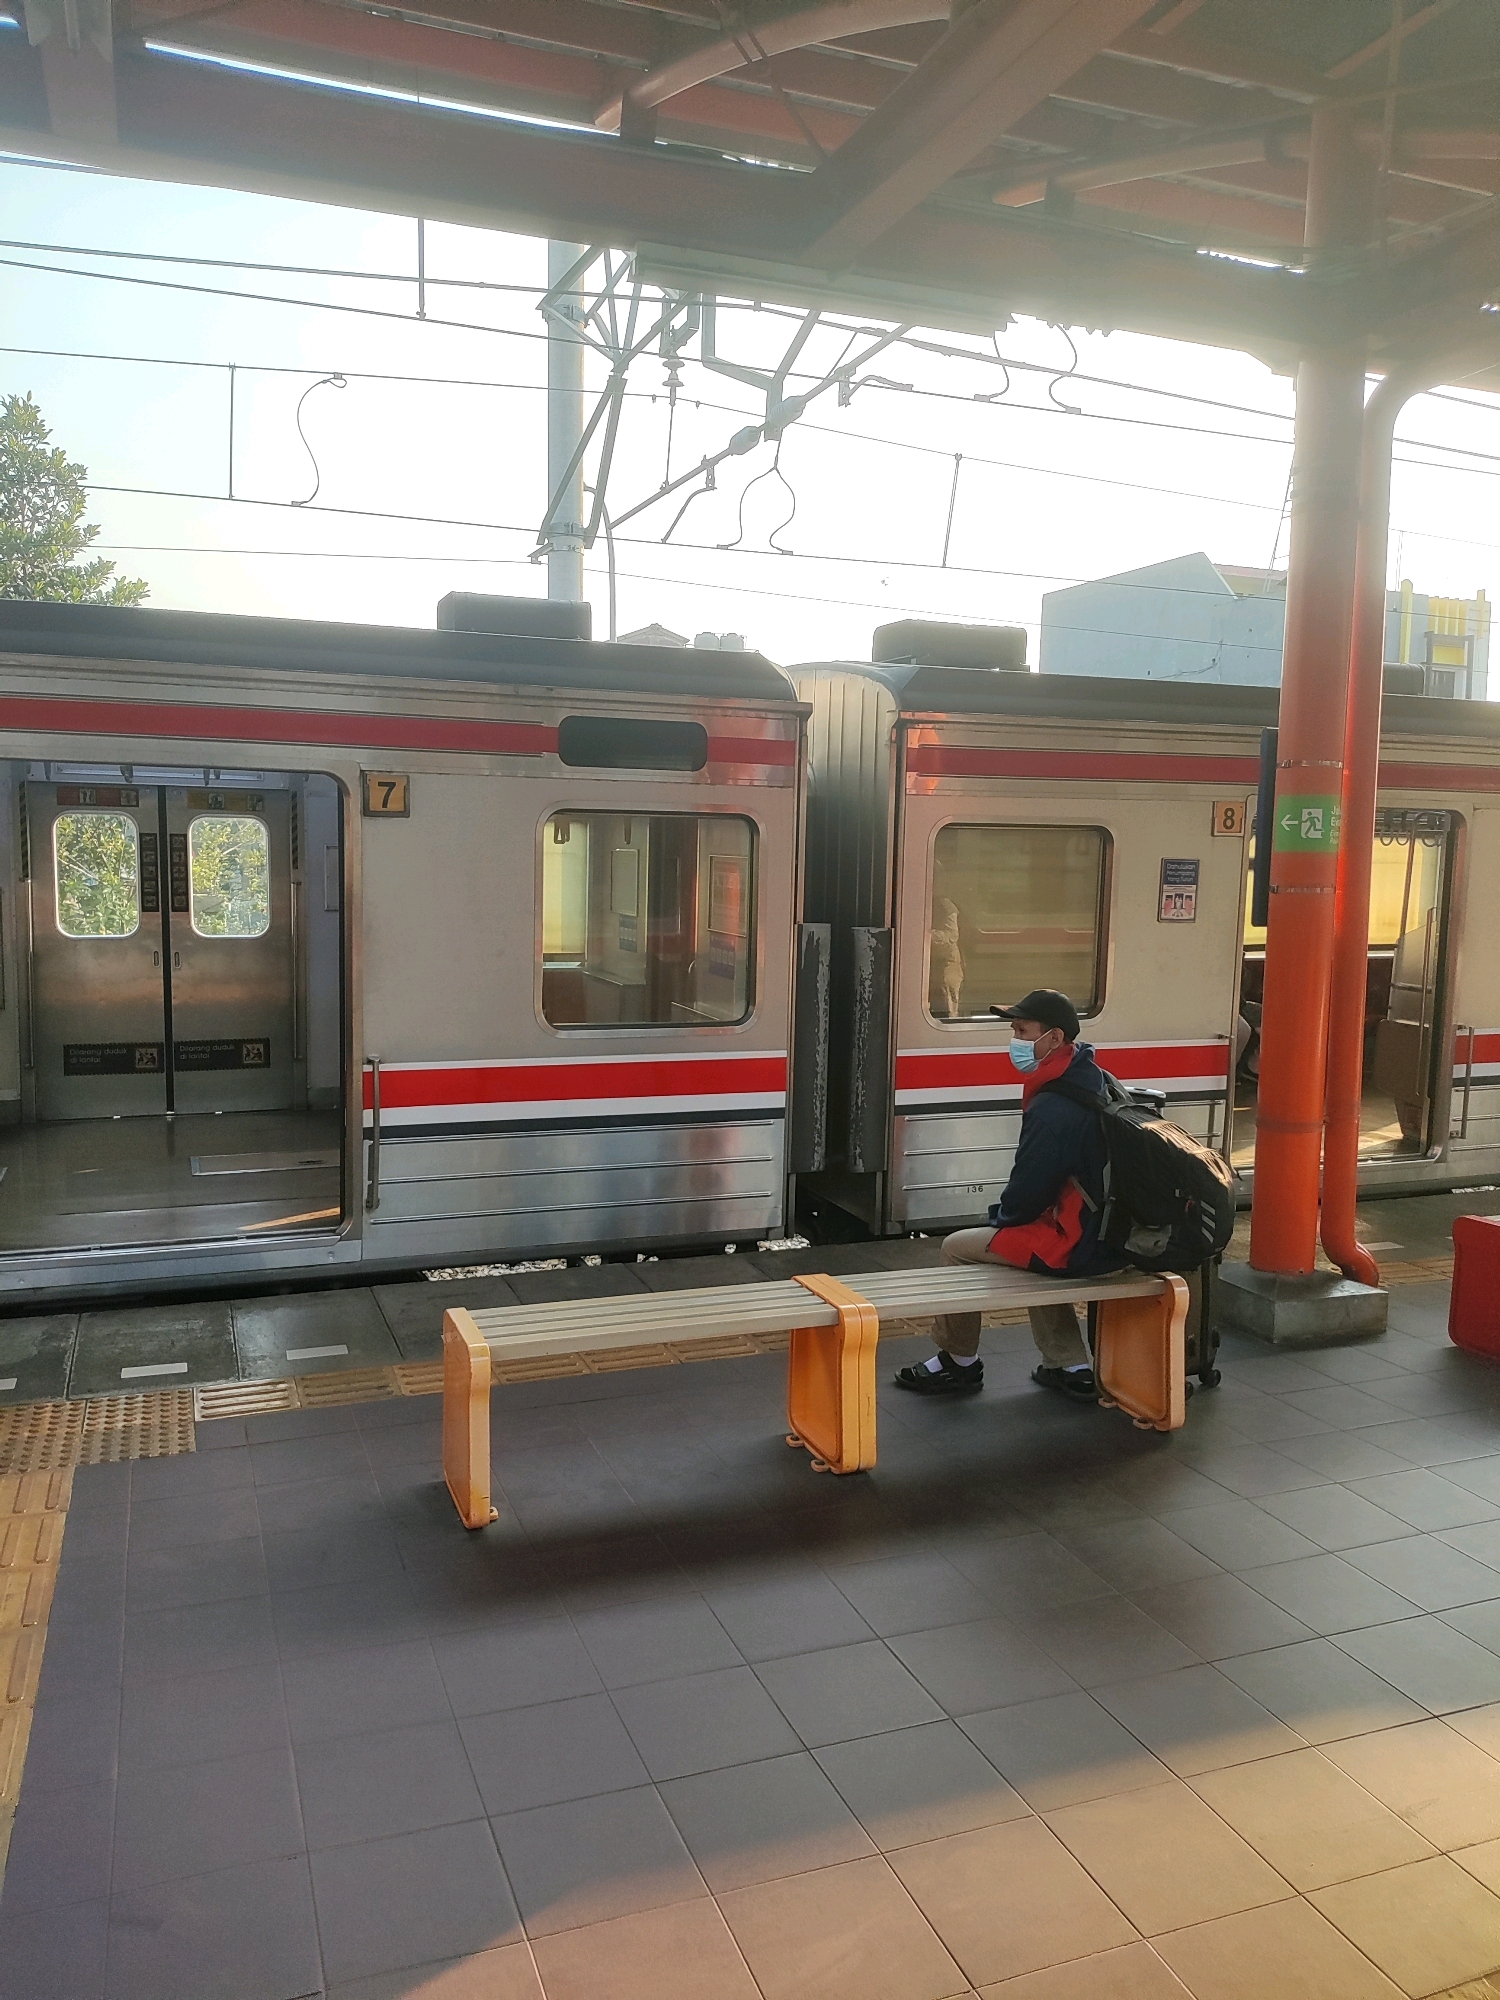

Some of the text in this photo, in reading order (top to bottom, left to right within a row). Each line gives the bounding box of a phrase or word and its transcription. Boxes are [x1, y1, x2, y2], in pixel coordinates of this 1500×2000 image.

[378, 781, 397, 809] 7
[1222, 807, 1235, 830] 8
[1166, 870, 1196, 878] Penumpang
[69, 1047, 127, 1056] Dilarang duduk
[179, 1045, 211, 1053] Dilarang
[967, 1185, 984, 1193] 136
